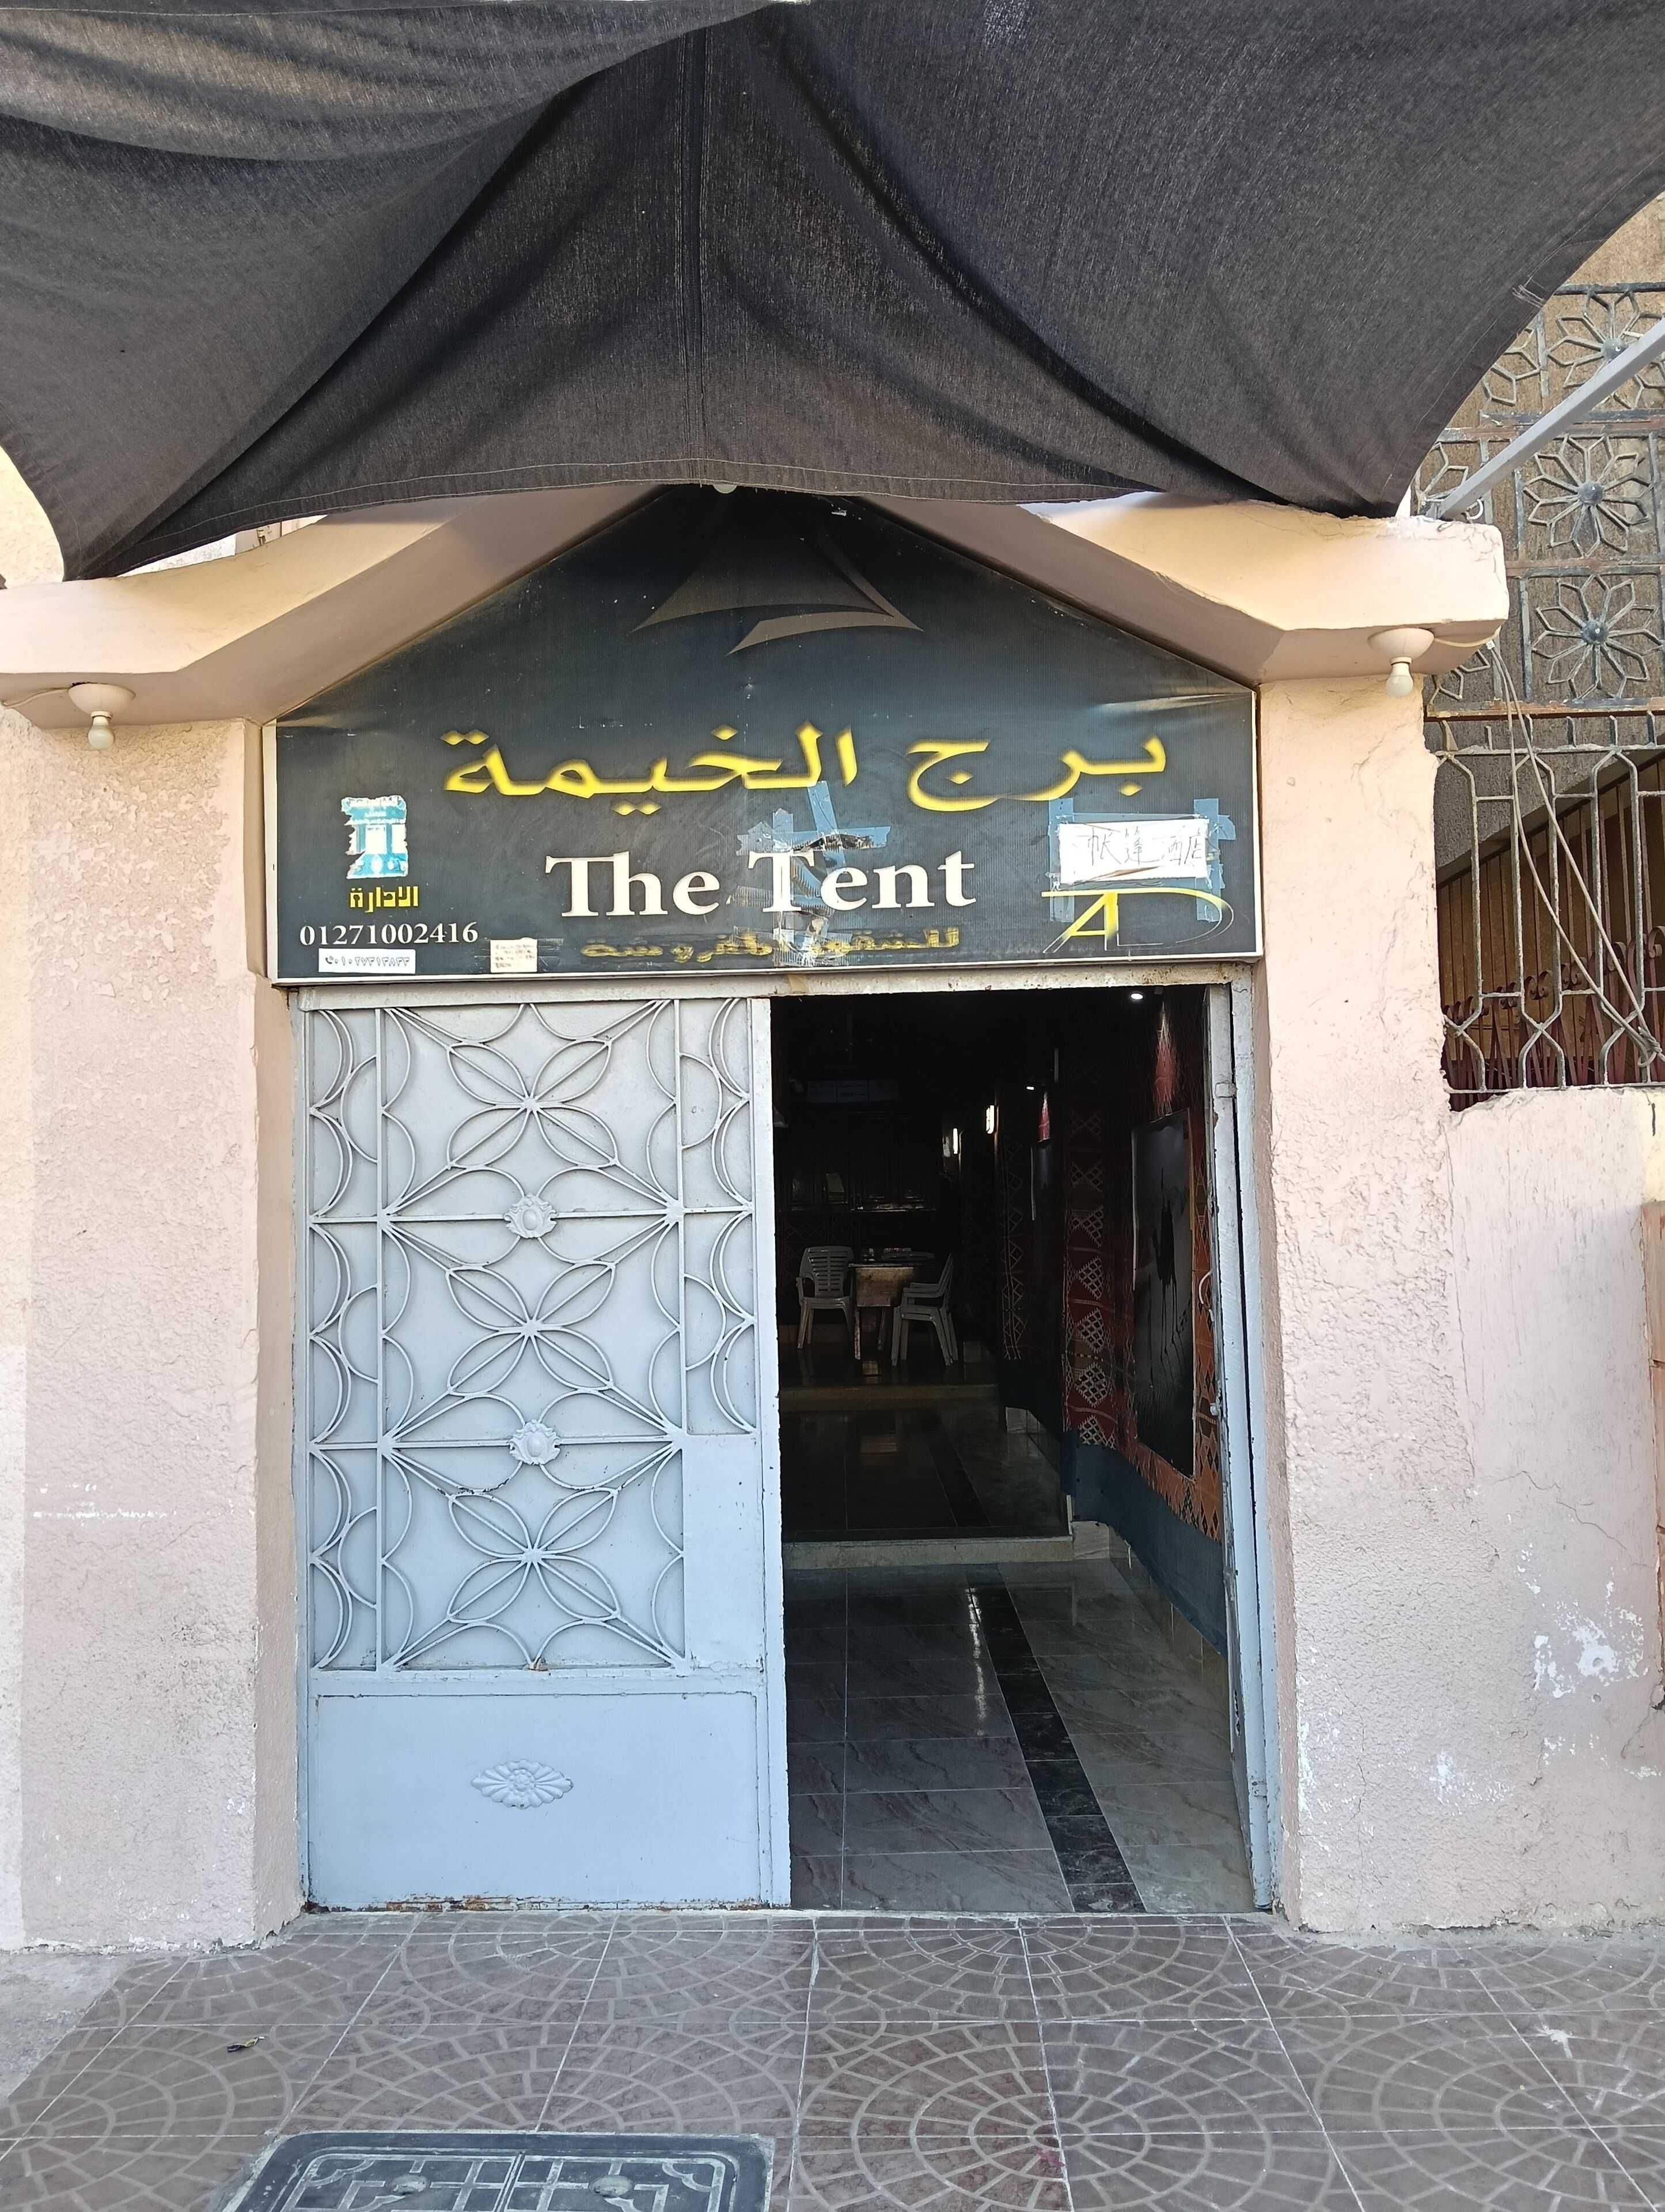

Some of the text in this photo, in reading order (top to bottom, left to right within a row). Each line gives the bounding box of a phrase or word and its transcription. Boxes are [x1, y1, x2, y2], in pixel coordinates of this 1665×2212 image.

[440, 721, 1166, 816] برج الخيمة
[545, 850, 977, 917] The Tent
[300, 922, 478, 945] 01271002416
